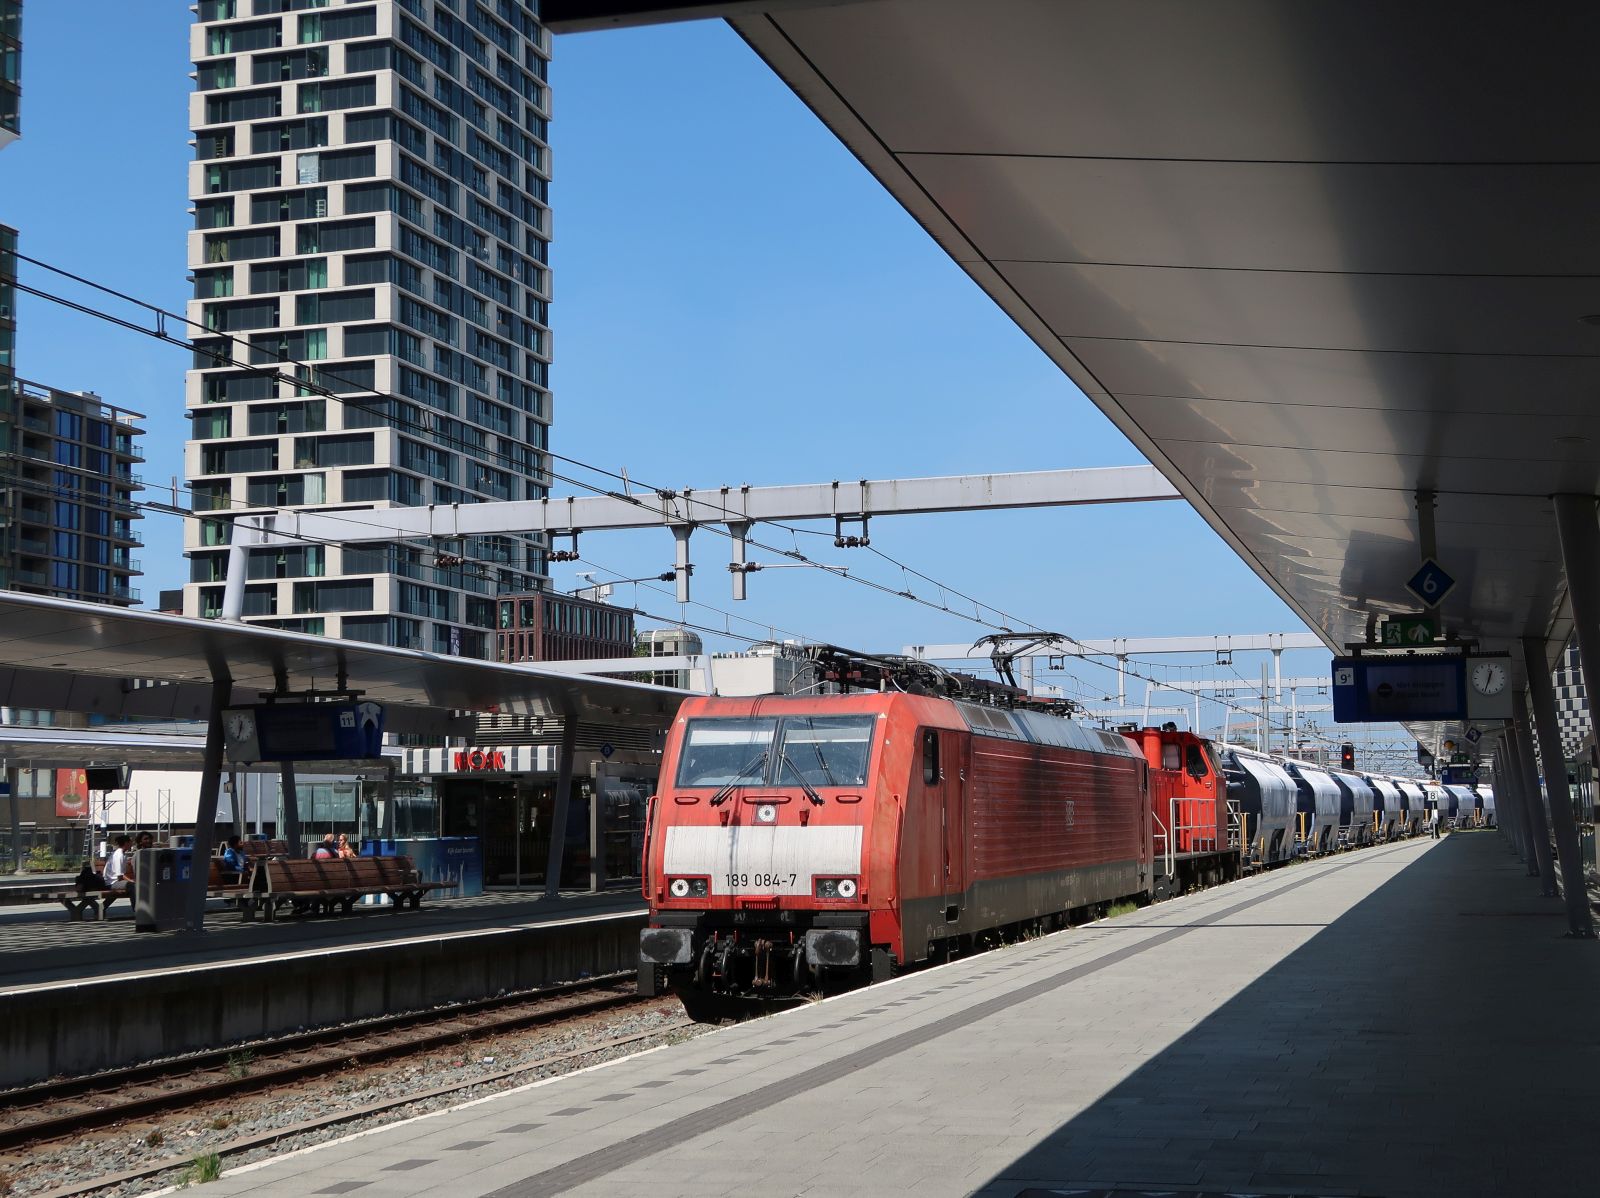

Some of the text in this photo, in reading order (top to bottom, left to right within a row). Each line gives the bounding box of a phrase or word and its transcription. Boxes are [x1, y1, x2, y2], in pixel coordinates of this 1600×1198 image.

[1423, 572, 1437, 594] 6
[453, 750, 505, 770] KIOSK
[725, 873, 797, 887] 189 084-7
